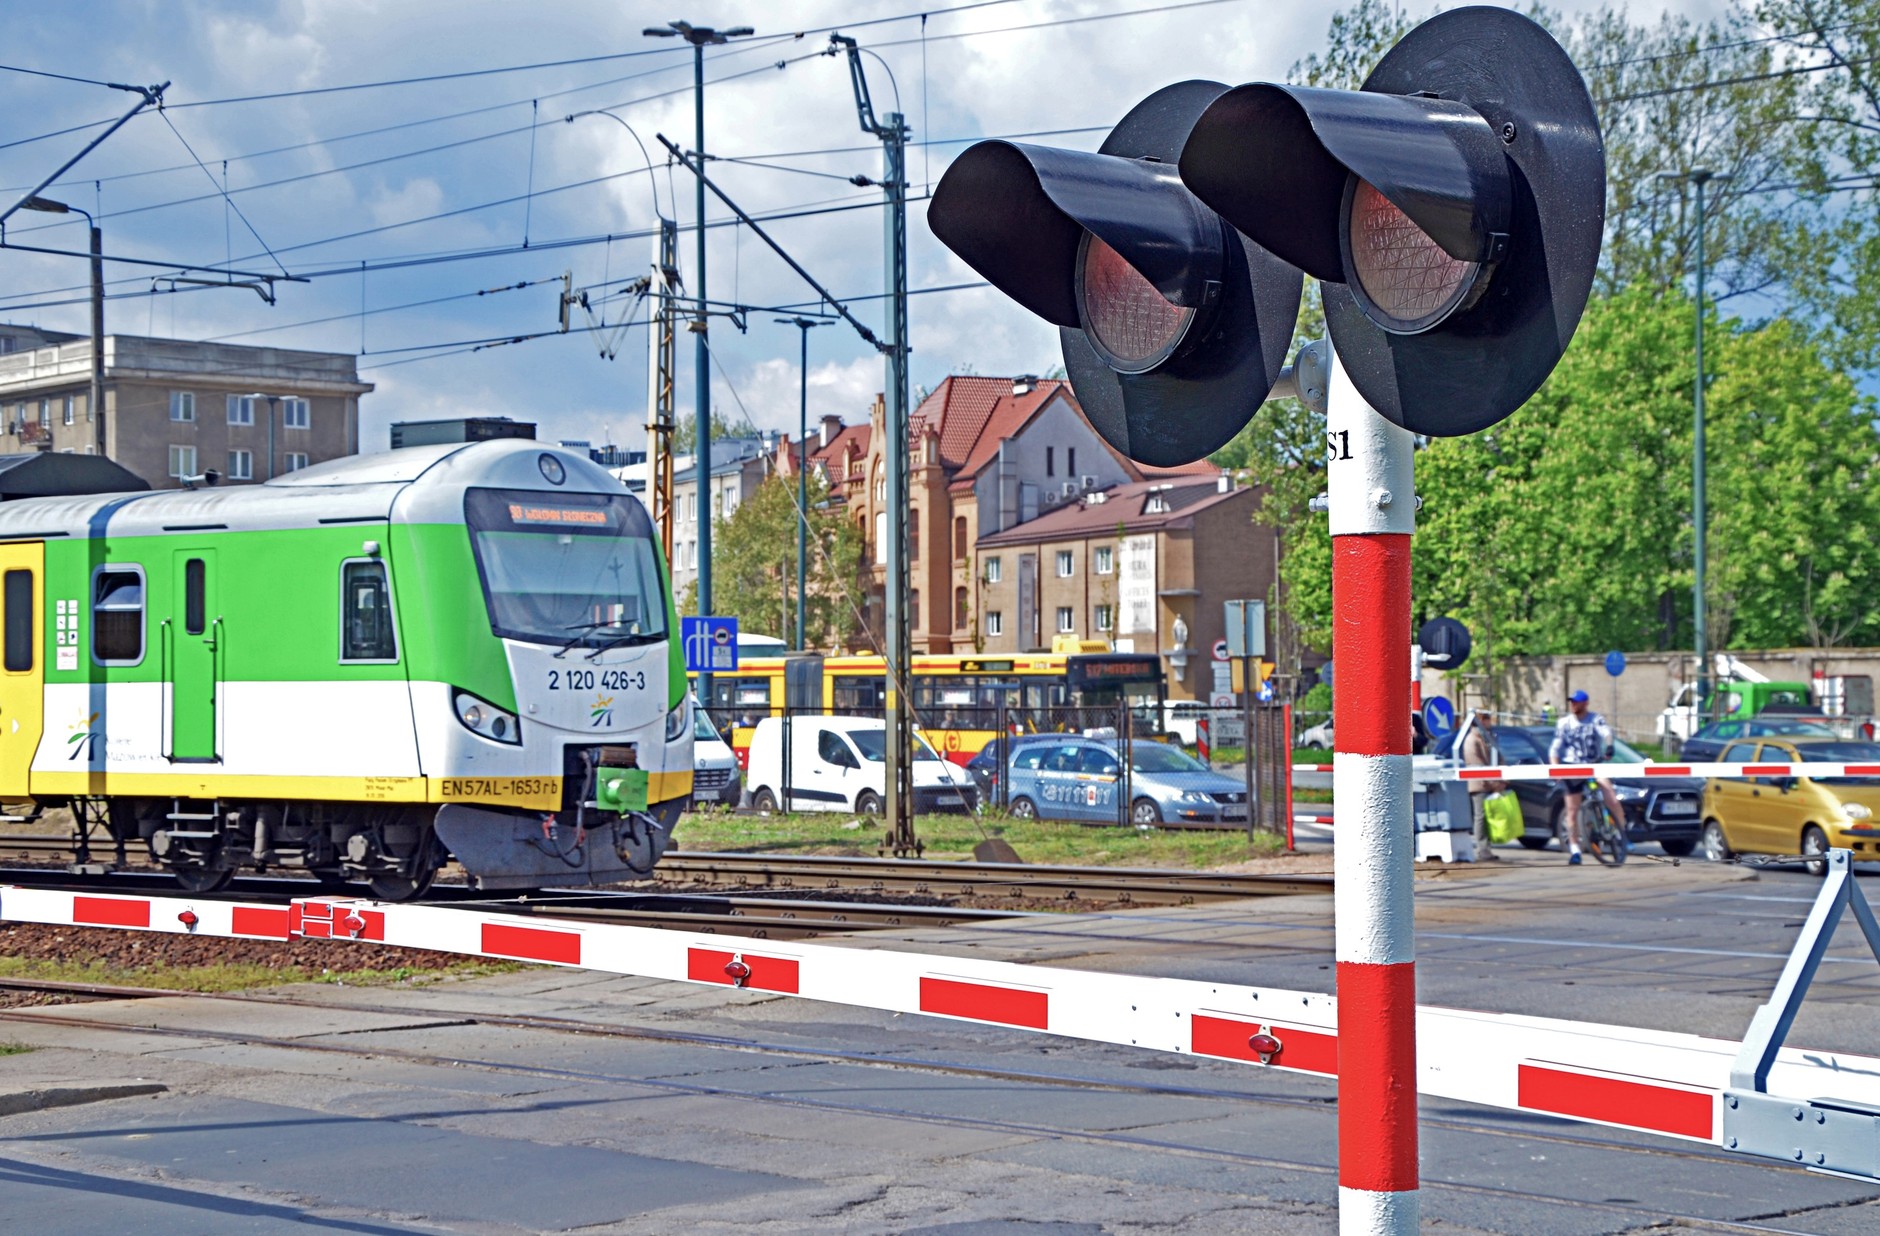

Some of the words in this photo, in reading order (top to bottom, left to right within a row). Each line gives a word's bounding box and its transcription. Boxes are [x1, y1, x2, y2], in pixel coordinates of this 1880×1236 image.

[1327, 430, 1354, 461] S1
[548, 670, 560, 690] 2
[566, 670, 594, 690] 120
[601, 670, 645, 690] 426-3
